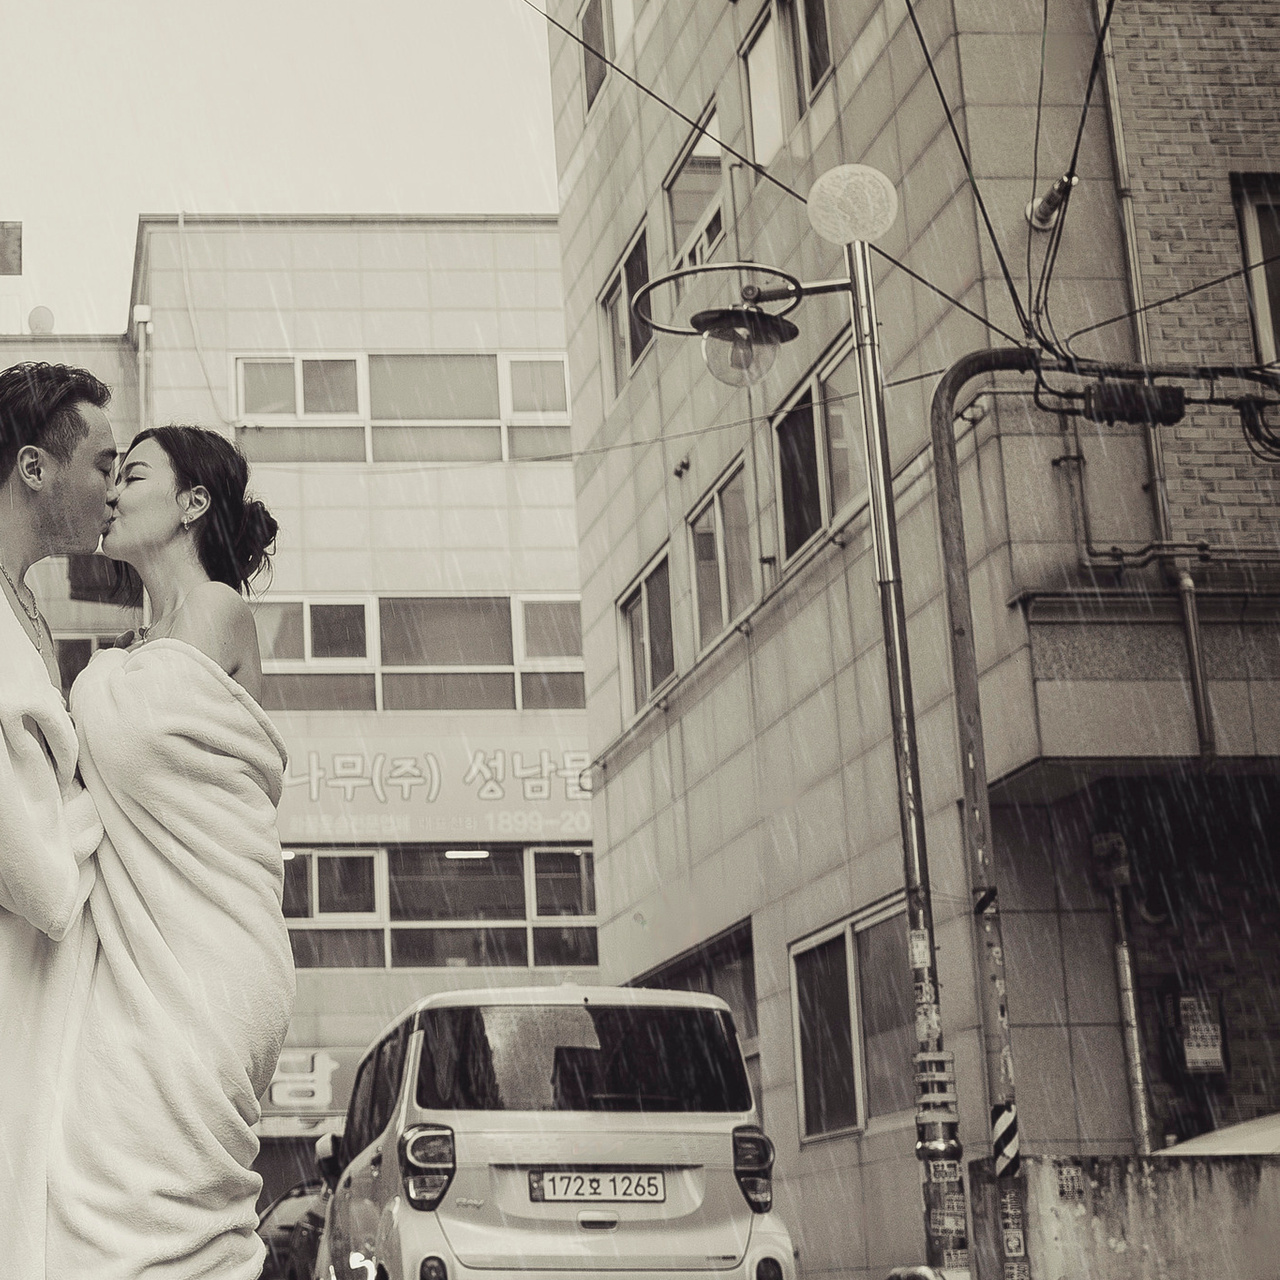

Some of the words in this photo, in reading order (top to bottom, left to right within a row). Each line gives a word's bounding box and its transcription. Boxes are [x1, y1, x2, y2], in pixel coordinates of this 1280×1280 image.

[283, 750, 441, 803] 나무(주)
[485, 810, 592, 834] 1899-20
[609, 1176, 659, 1196] 1265
